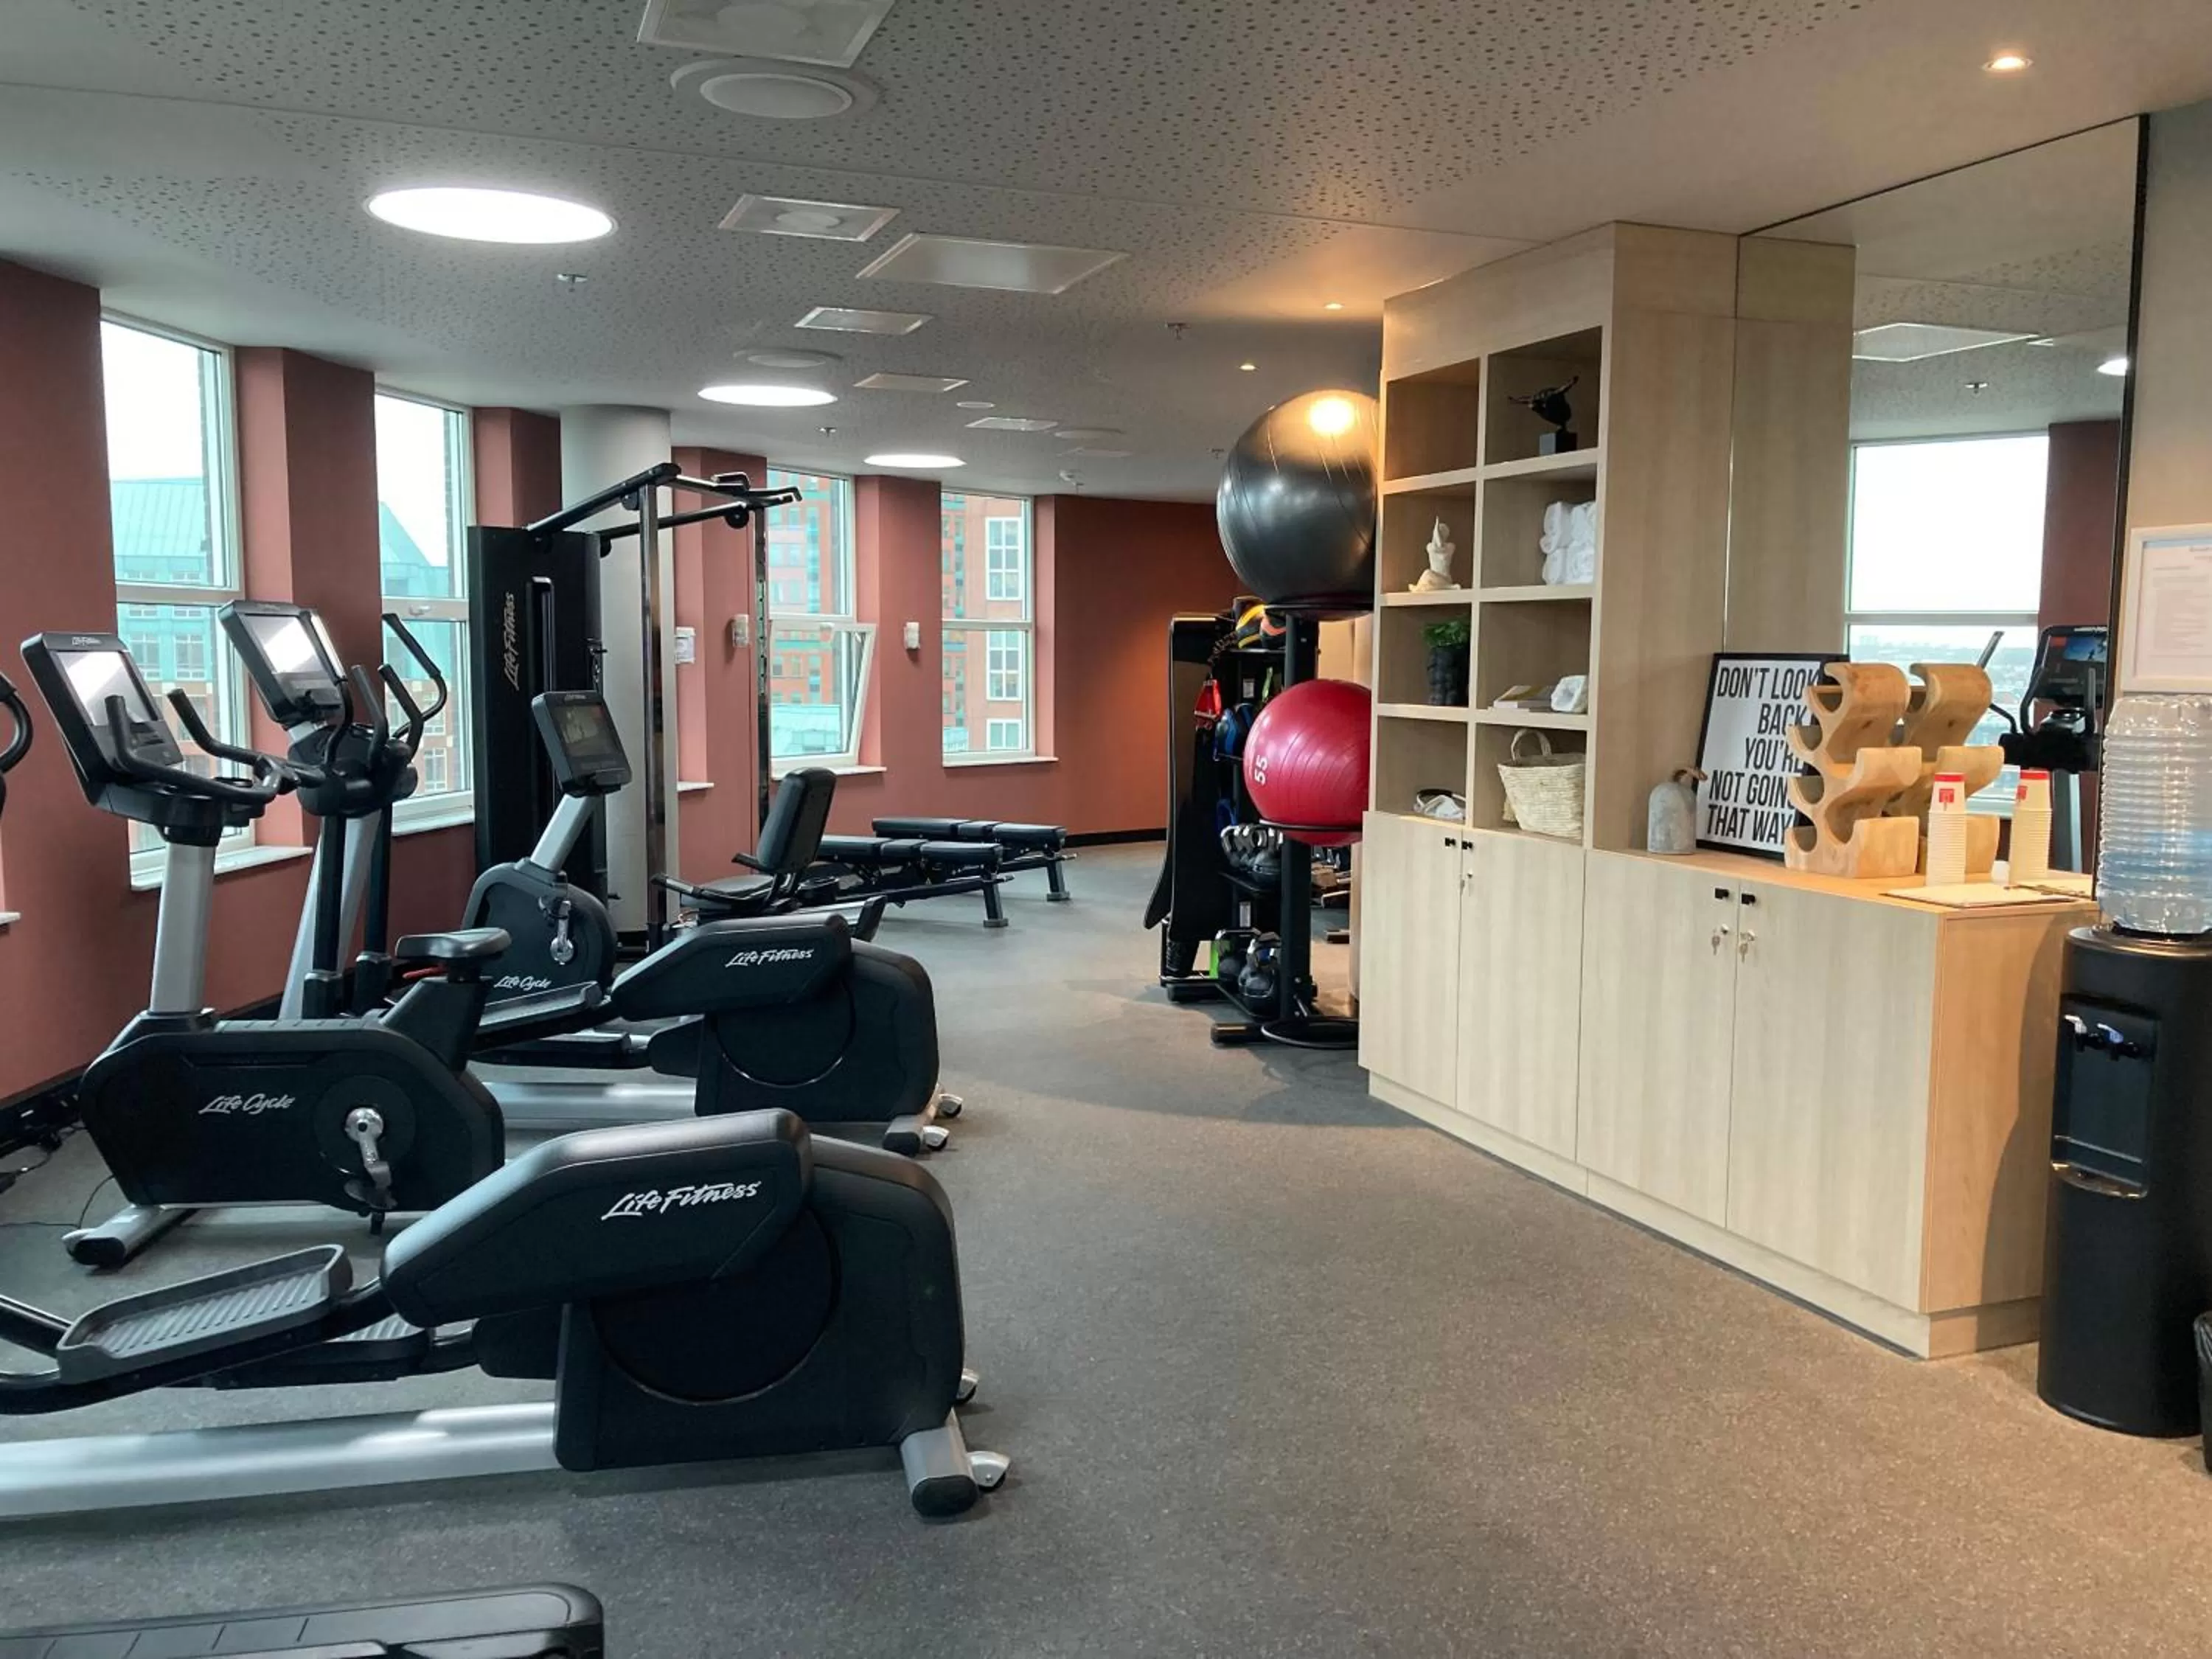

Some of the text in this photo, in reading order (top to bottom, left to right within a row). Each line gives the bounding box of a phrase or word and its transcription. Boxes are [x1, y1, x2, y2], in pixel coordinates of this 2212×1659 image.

[1717, 667, 1770, 700] DON'T
[1757, 703, 1807, 736] BACK
[1254, 754, 1268, 786] 55
[1709, 770, 1795, 810] NOT GOIN
[1707, 804, 1793, 846] THAT WAY
[198, 1095, 243, 1115] Life
[601, 1180, 762, 1221] Life Fitness
